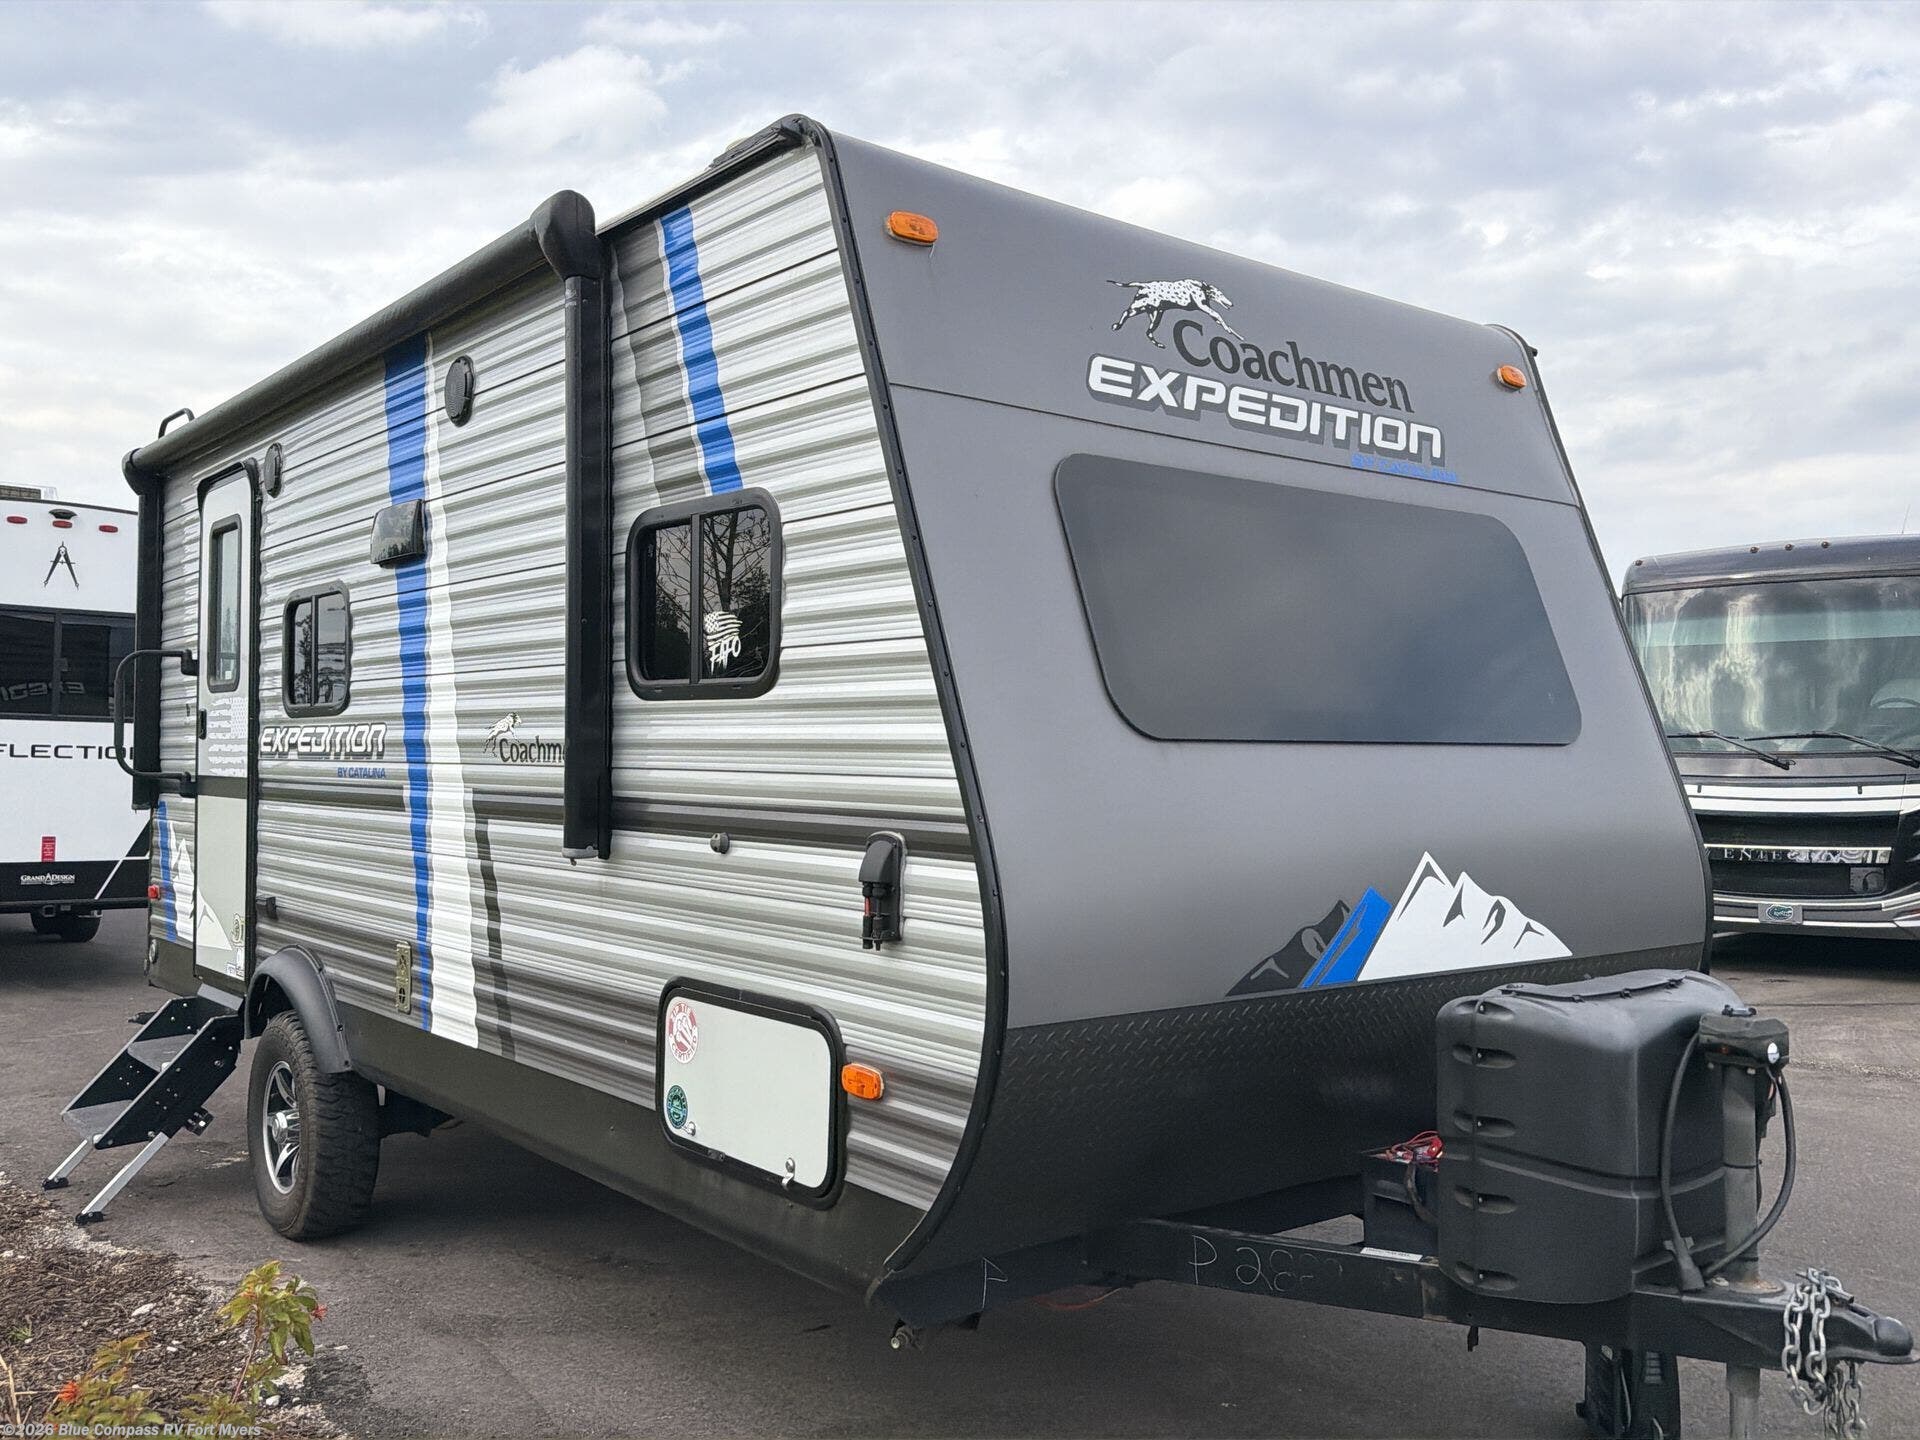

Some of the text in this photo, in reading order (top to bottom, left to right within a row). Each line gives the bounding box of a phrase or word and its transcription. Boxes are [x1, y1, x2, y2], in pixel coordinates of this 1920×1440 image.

[1172, 318, 1415, 414] Coachmen
[1087, 353, 1445, 466] EXPEDITION
[0, 743, 134, 760] LECTIO
[260, 722, 387, 759] EXPEDITION
[337, 767, 386, 778] BY CATALINA
